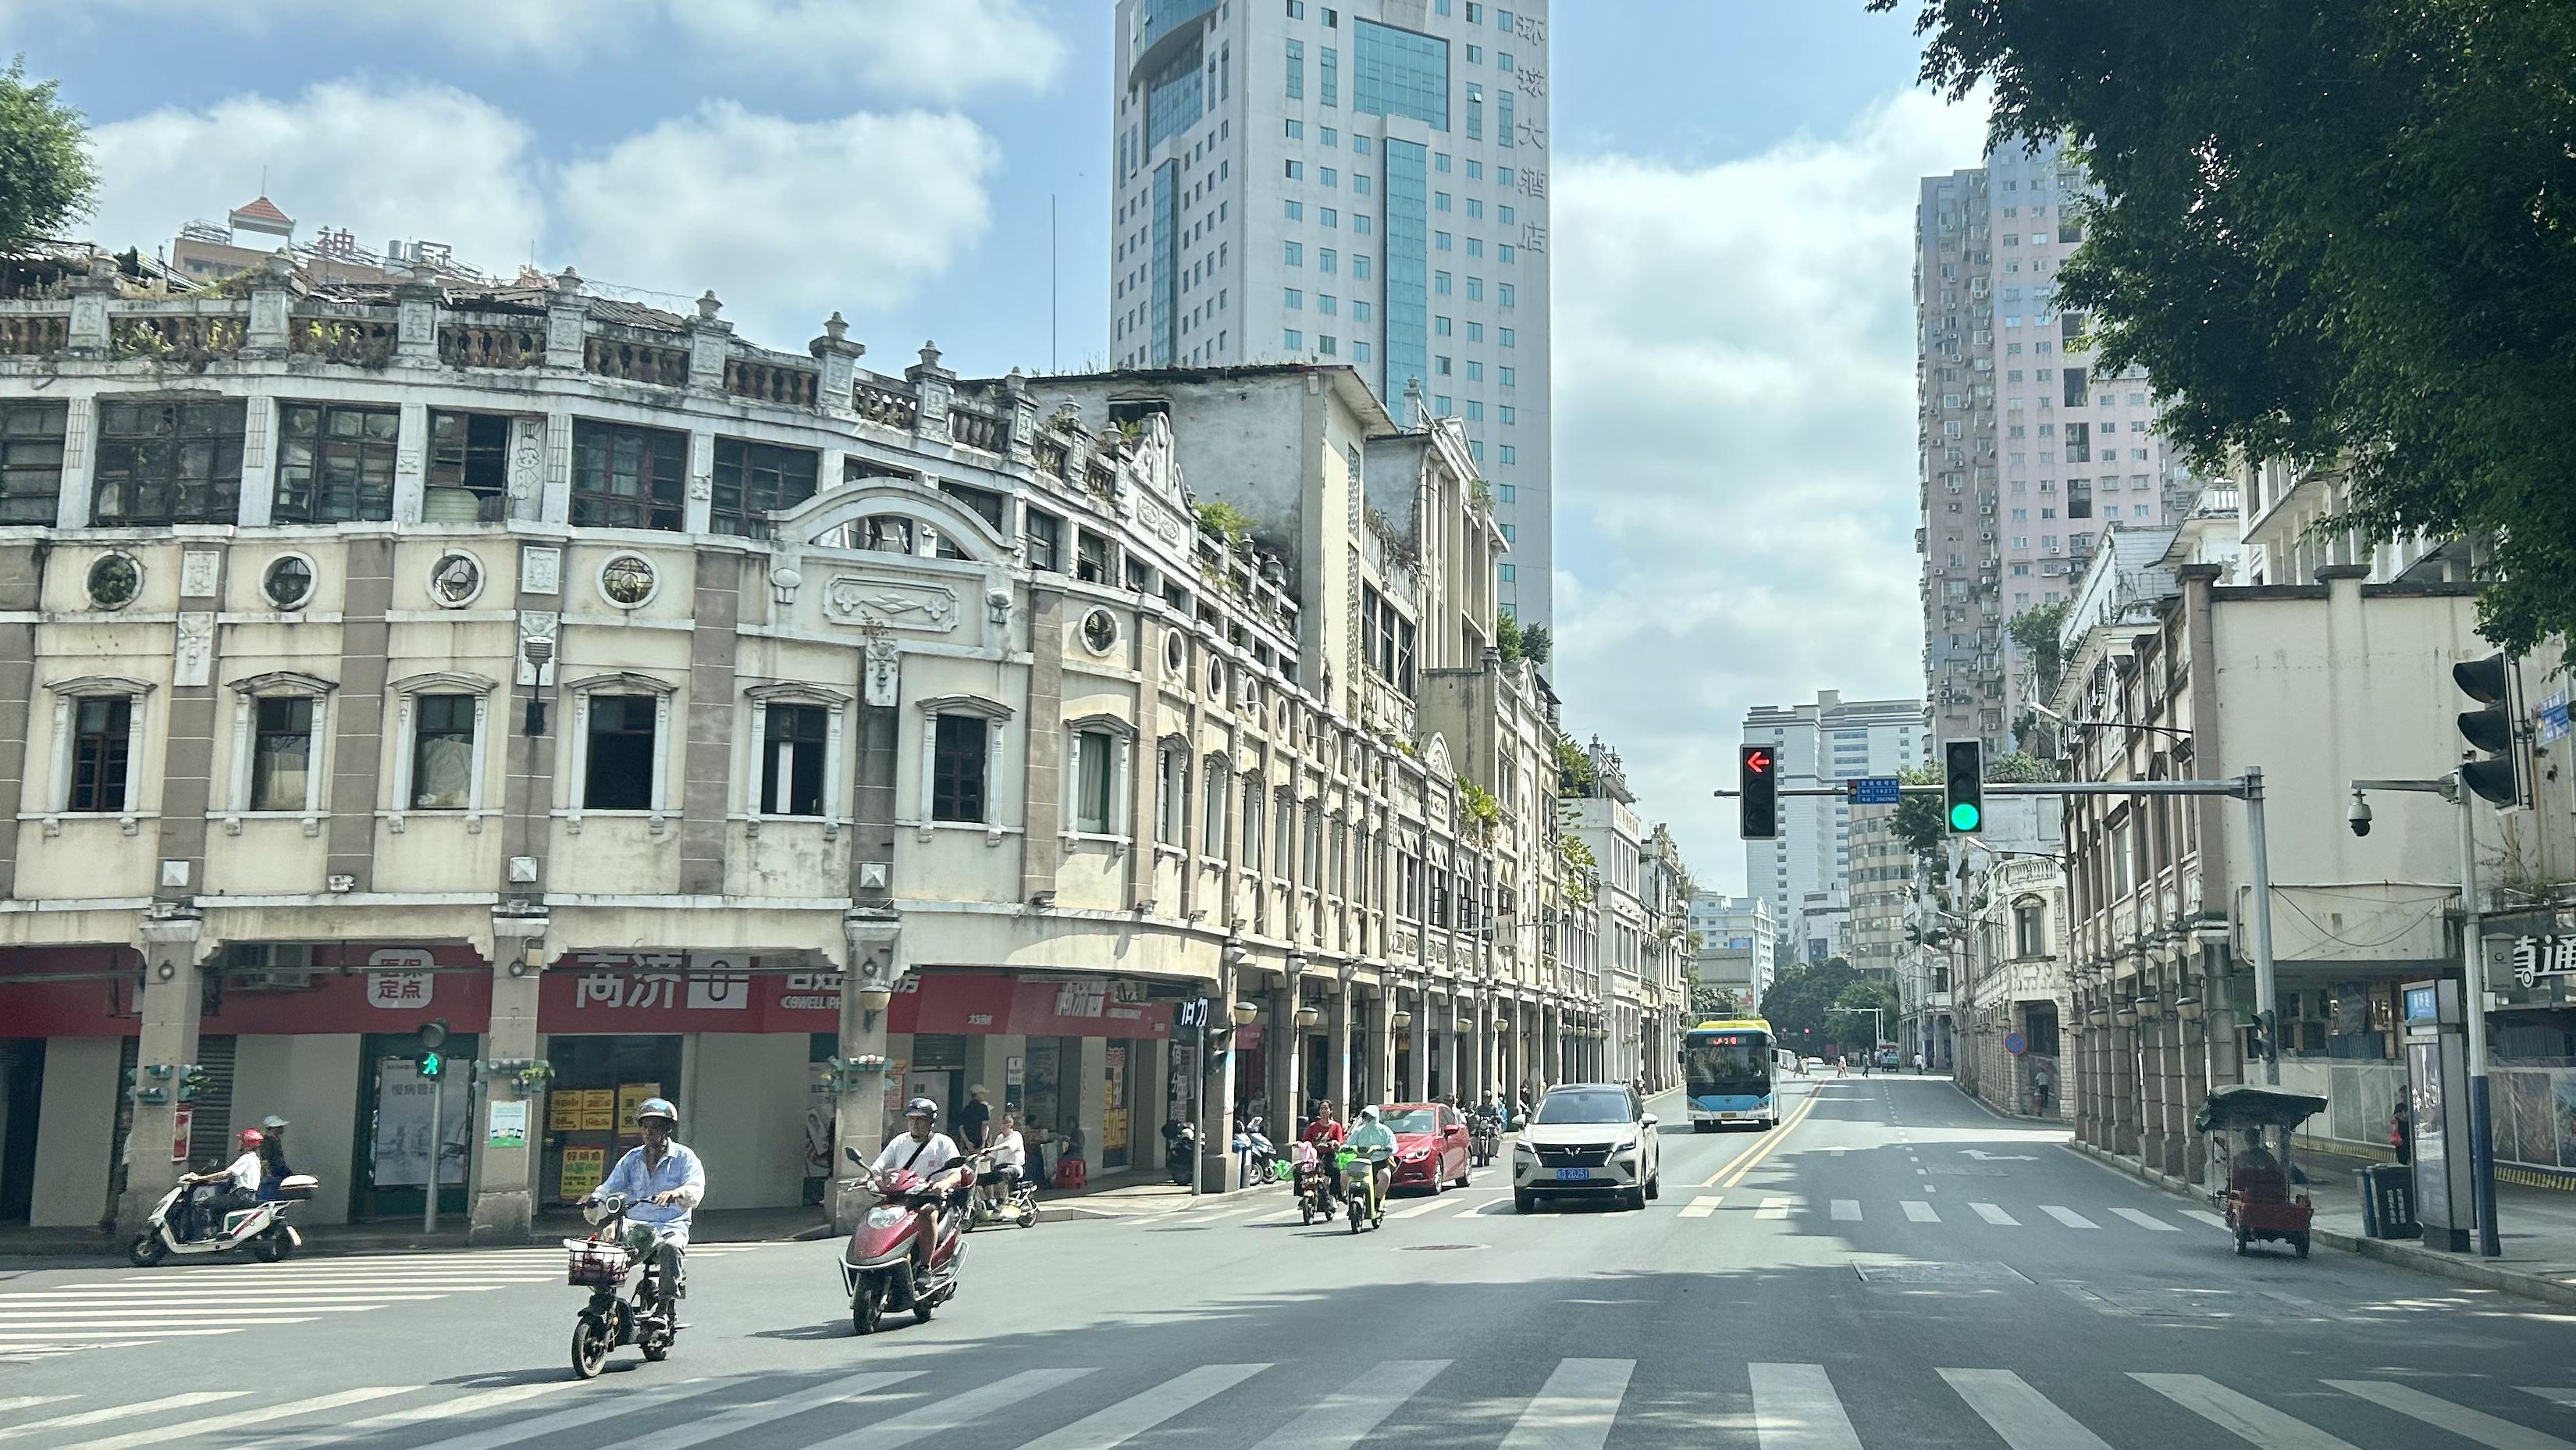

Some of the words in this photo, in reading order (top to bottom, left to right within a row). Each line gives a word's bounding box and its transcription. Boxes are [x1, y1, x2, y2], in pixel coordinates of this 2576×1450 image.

[1516, 14, 1546, 253] 环球大酒店
[378, 980, 422, 999] 定点
